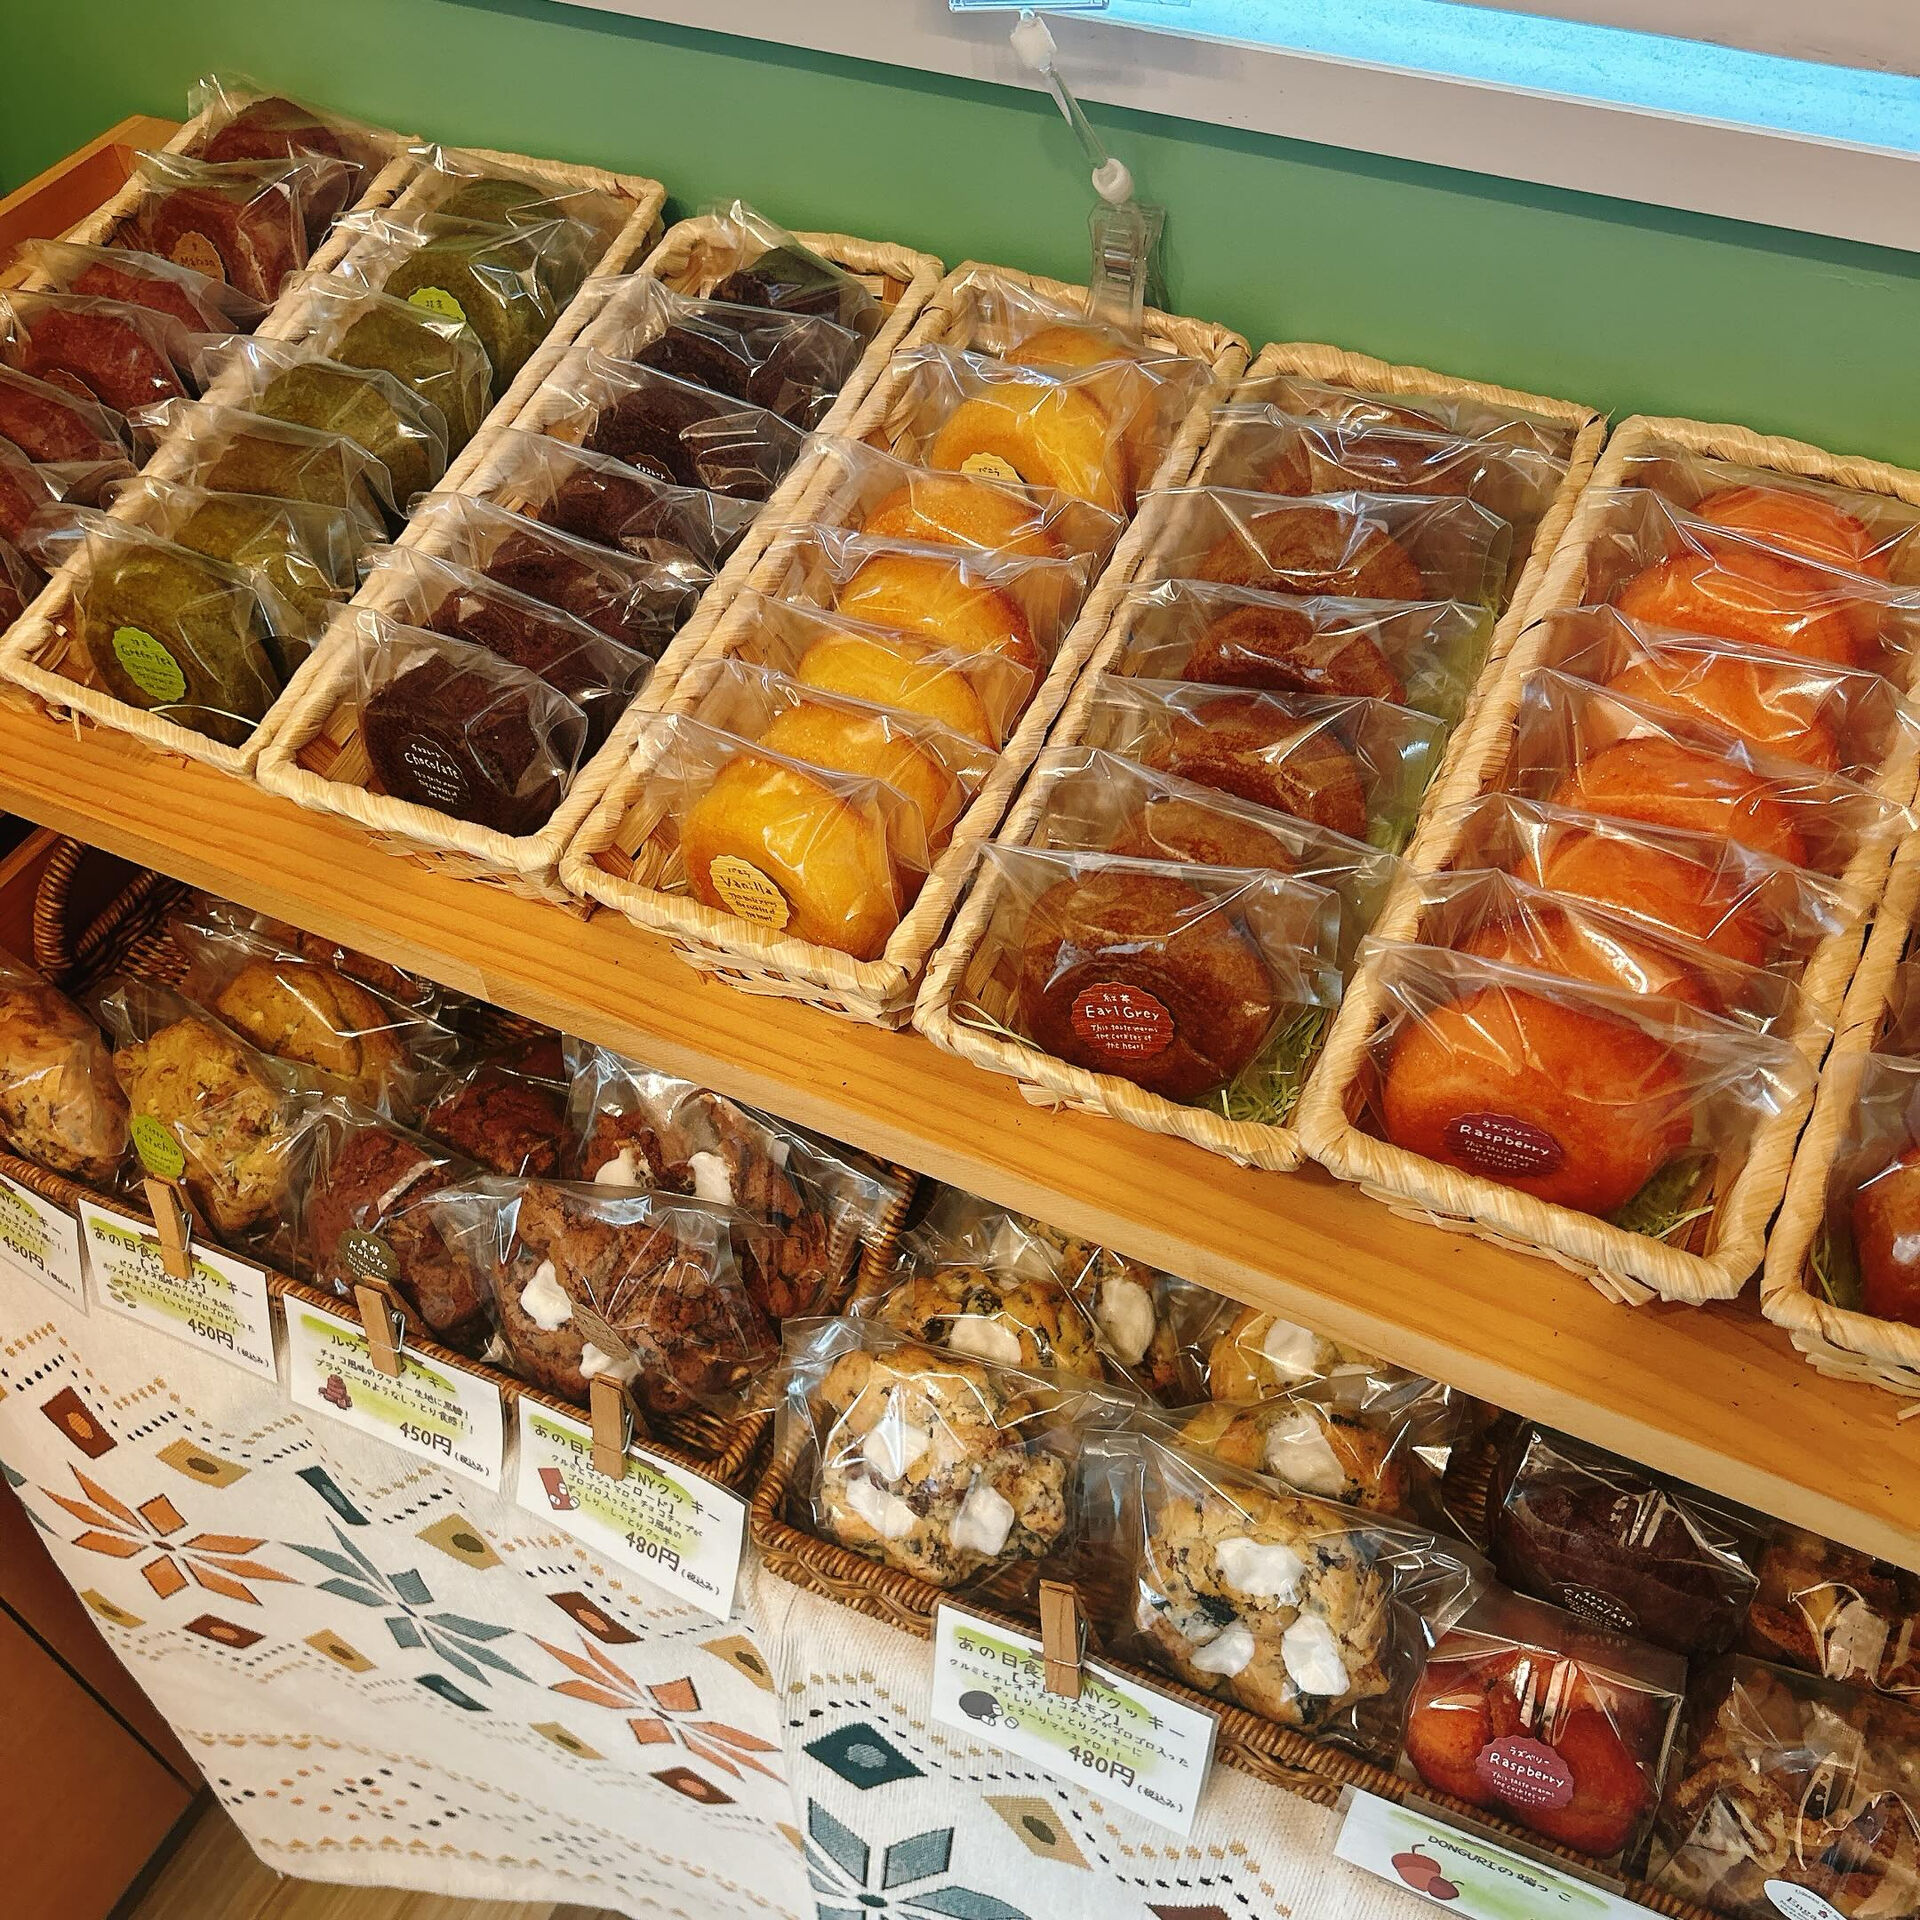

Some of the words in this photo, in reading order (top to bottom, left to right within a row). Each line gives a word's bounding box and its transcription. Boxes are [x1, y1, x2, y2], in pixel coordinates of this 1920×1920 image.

[404, 752, 460, 780] Chocolate
[719, 875, 773, 896] Vanilla
[1085, 1004, 1120, 1019] Earl
[1122, 1006, 1160, 1021] Grey
[1102, 992, 1132, 1004] 紅茶
[135, 1126, 179, 1157] Pistachio
[1459, 1124, 1550, 1156] Raspberry
[1482, 1120, 1532, 1137] ラズベリー
[2, 1232, 44, 1272] 450円
[186, 1315, 234, 1351] 450円
[399, 1418, 452, 1458] 450円
[574, 1454, 674, 1515] 【ローロード】
[624, 1527, 680, 1574] 480円
[1563, 1588, 1634, 1628] Chocolate
[957, 1633, 1185, 1738] あの日食NYクッキー
[1067, 1741, 1135, 1789] 480円
[1489, 1752, 1565, 1788] Raspberry
[1509, 1746, 1550, 1764] ラズベリー
